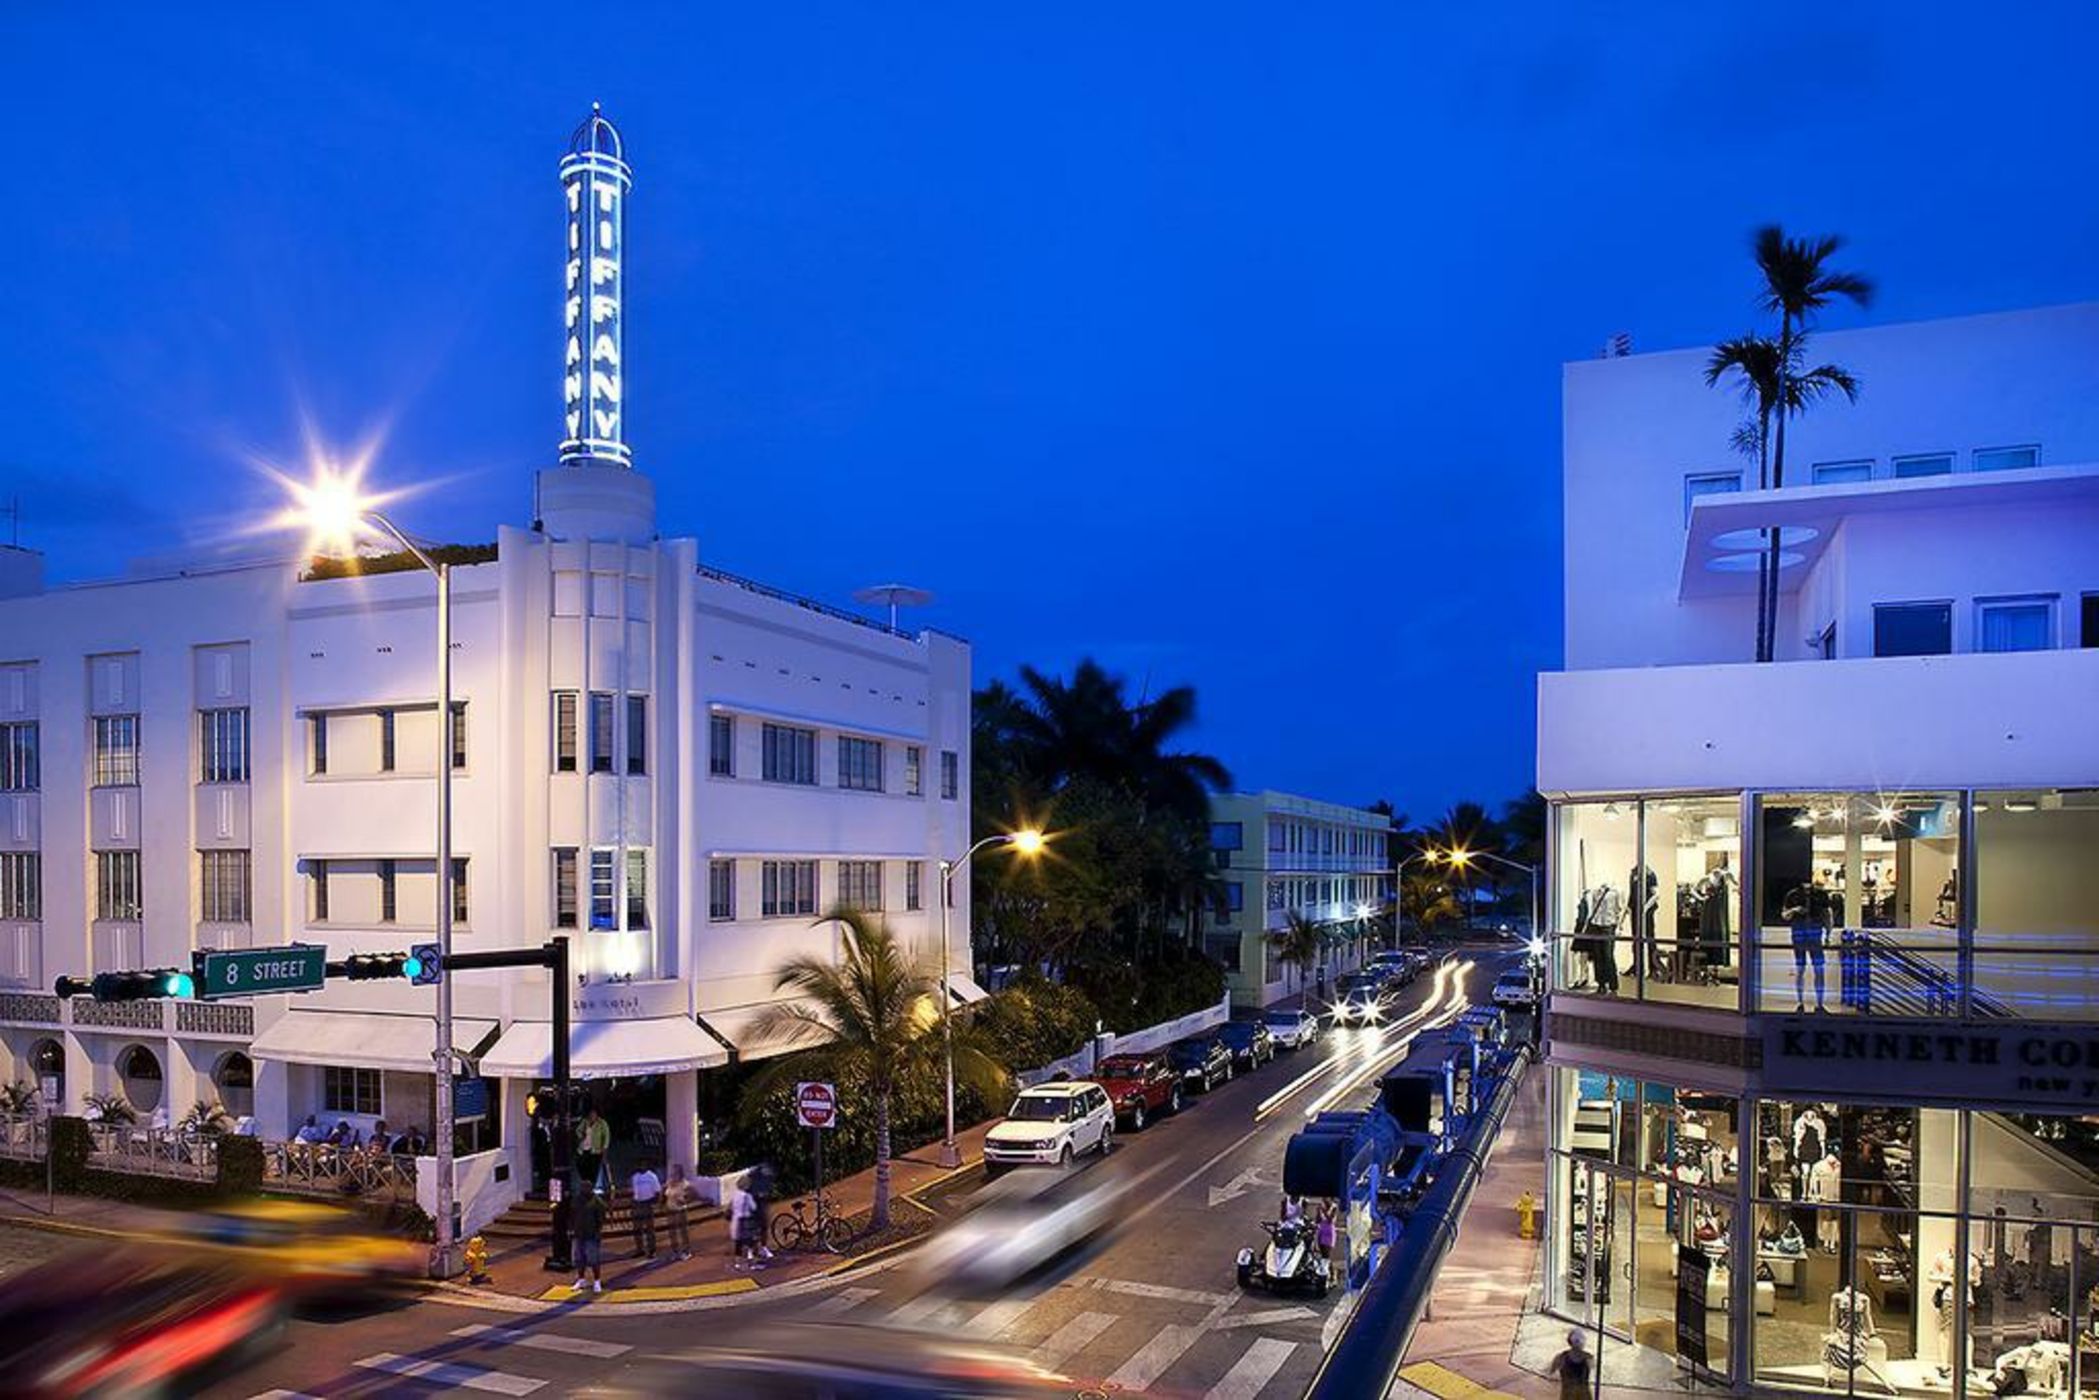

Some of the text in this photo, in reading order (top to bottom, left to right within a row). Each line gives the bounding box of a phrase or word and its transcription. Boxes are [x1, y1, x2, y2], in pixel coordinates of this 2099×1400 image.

[564, 182, 581, 440] TIFFANY
[591, 180, 618, 438] TIFFANY
[226, 961, 306, 984] 8 STREET
[1782, 1030, 2001, 1065] KENNETH
[2018, 1076, 2072, 1091] new
